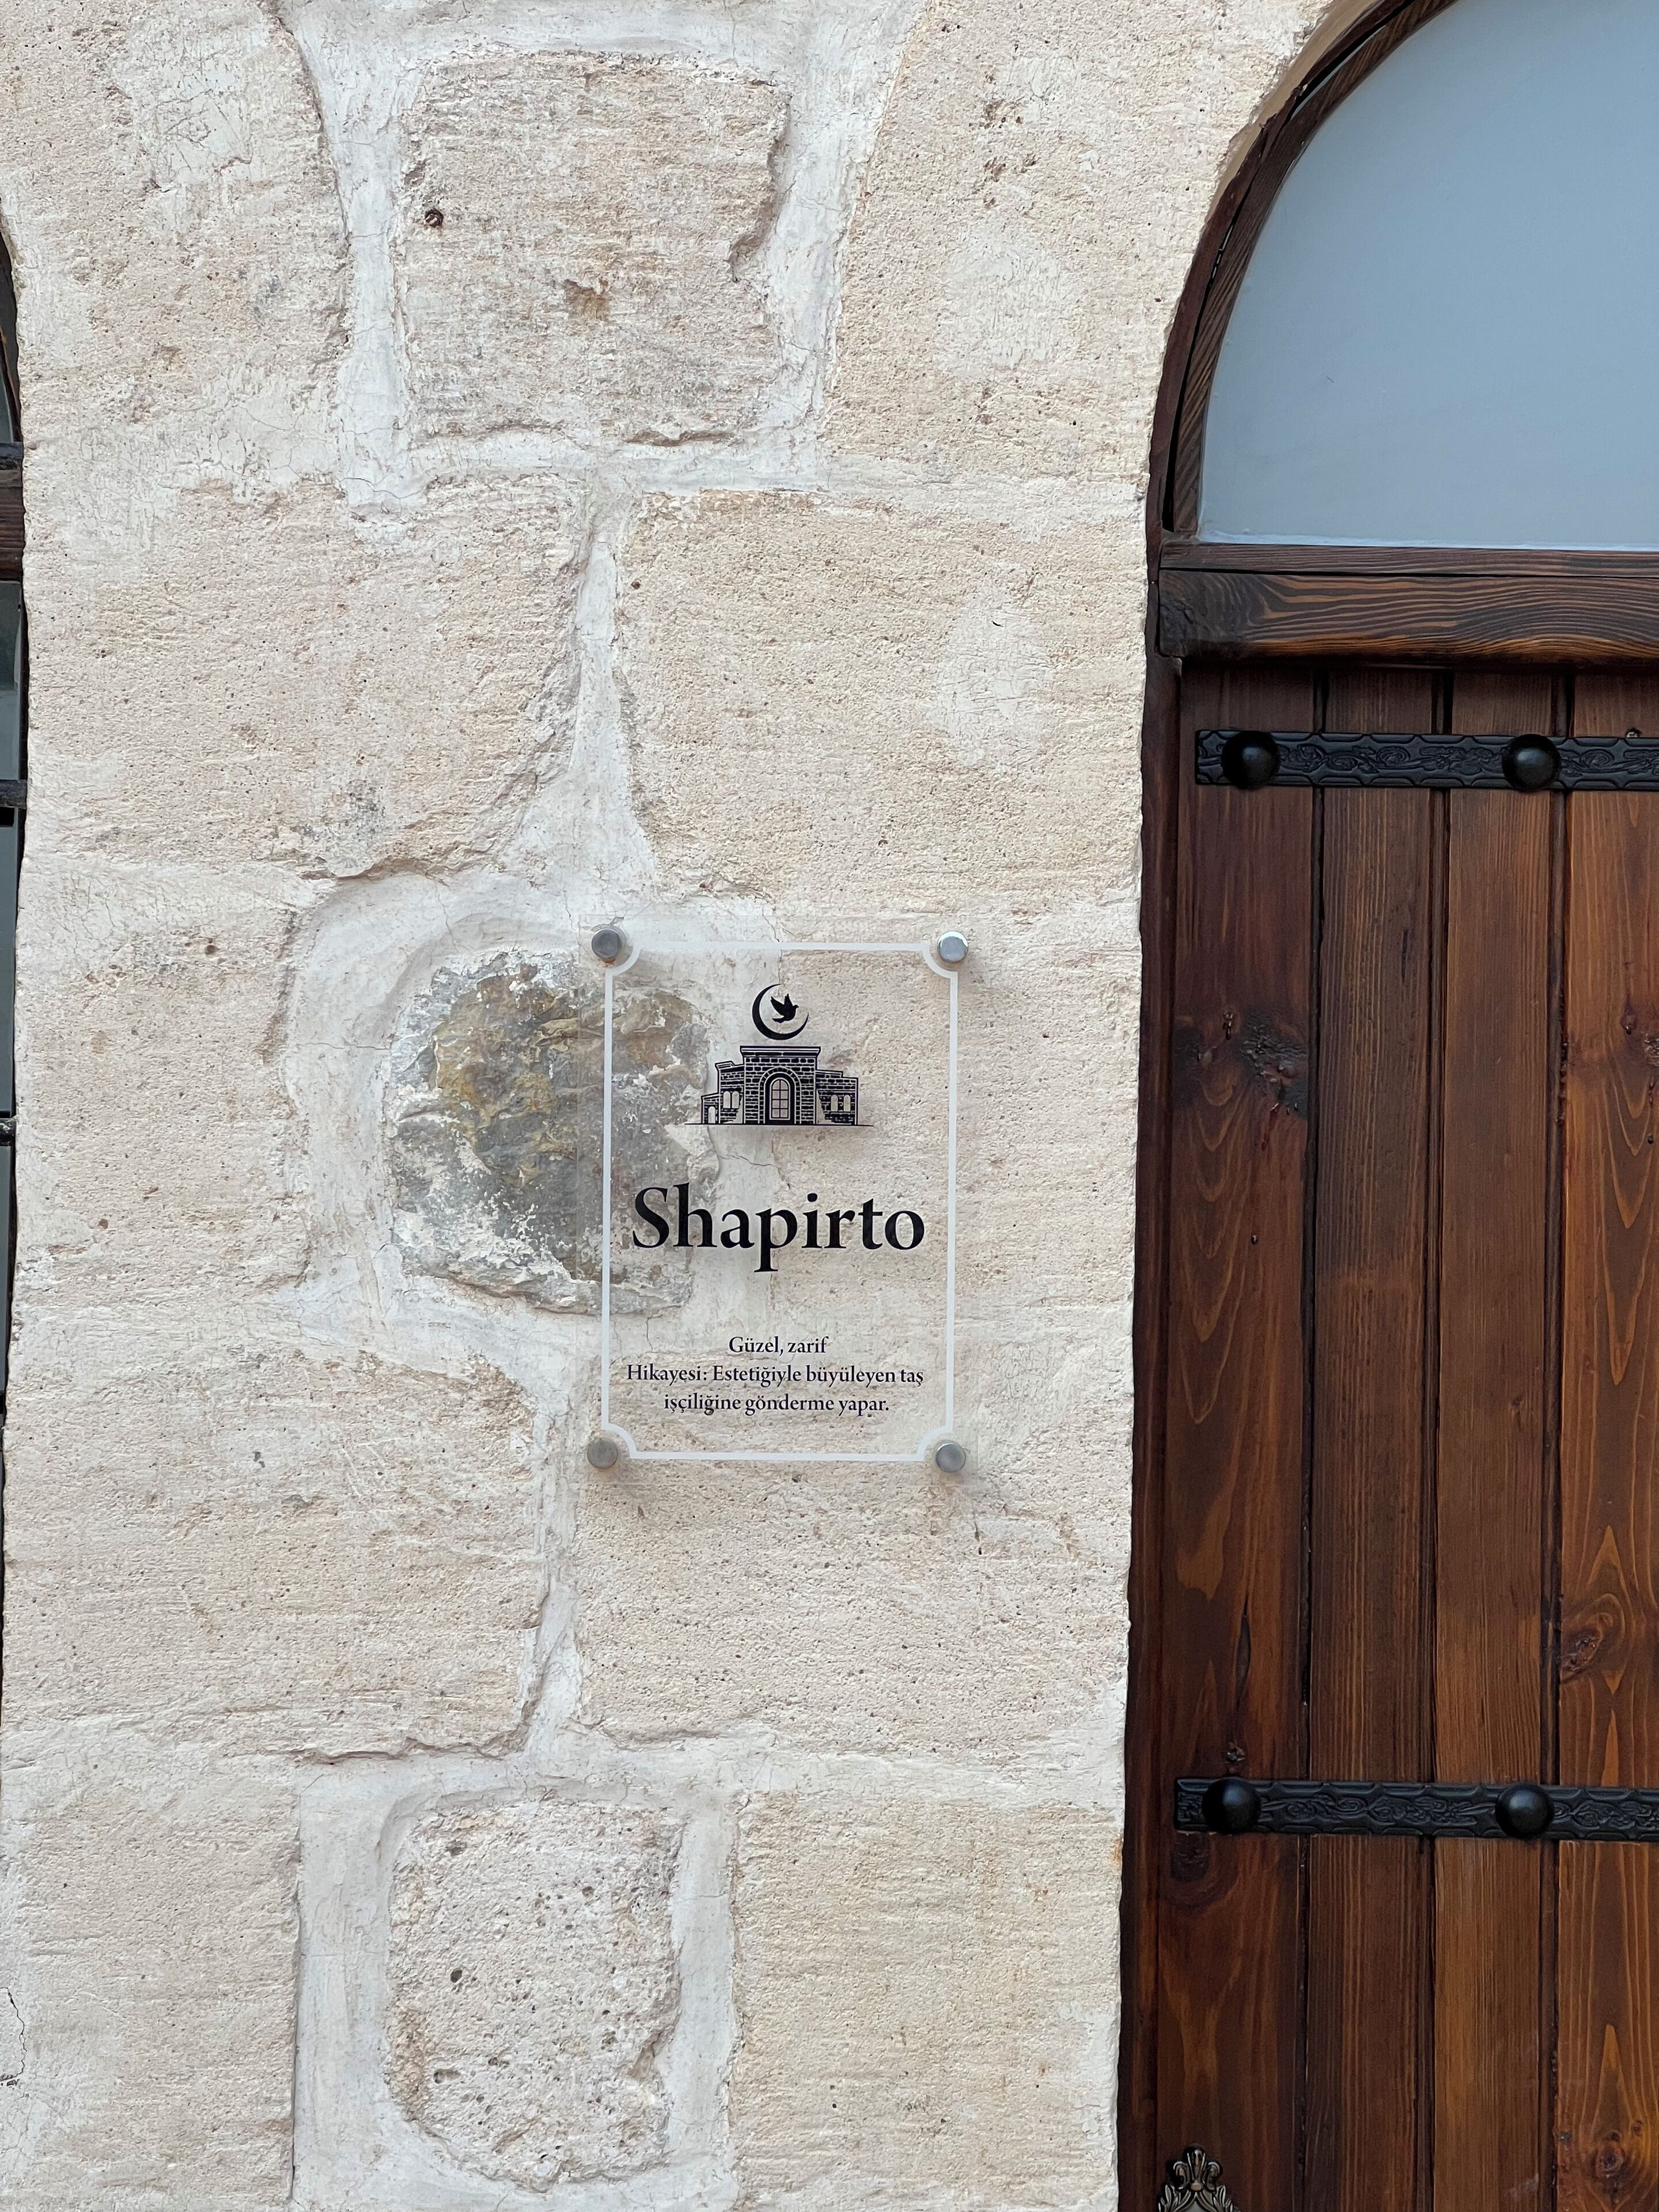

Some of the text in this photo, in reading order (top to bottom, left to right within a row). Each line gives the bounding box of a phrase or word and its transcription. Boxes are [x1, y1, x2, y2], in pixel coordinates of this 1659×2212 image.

[631, 1181, 925, 1273] Shapirto
[729, 1336, 829, 1355] Güzel, zarif
[627, 1364, 924, 1388] Hikayesi: Estetiğiyle büyüleyen taş
[664, 1393, 890, 1417] işçiliğine gönderme yapar.
